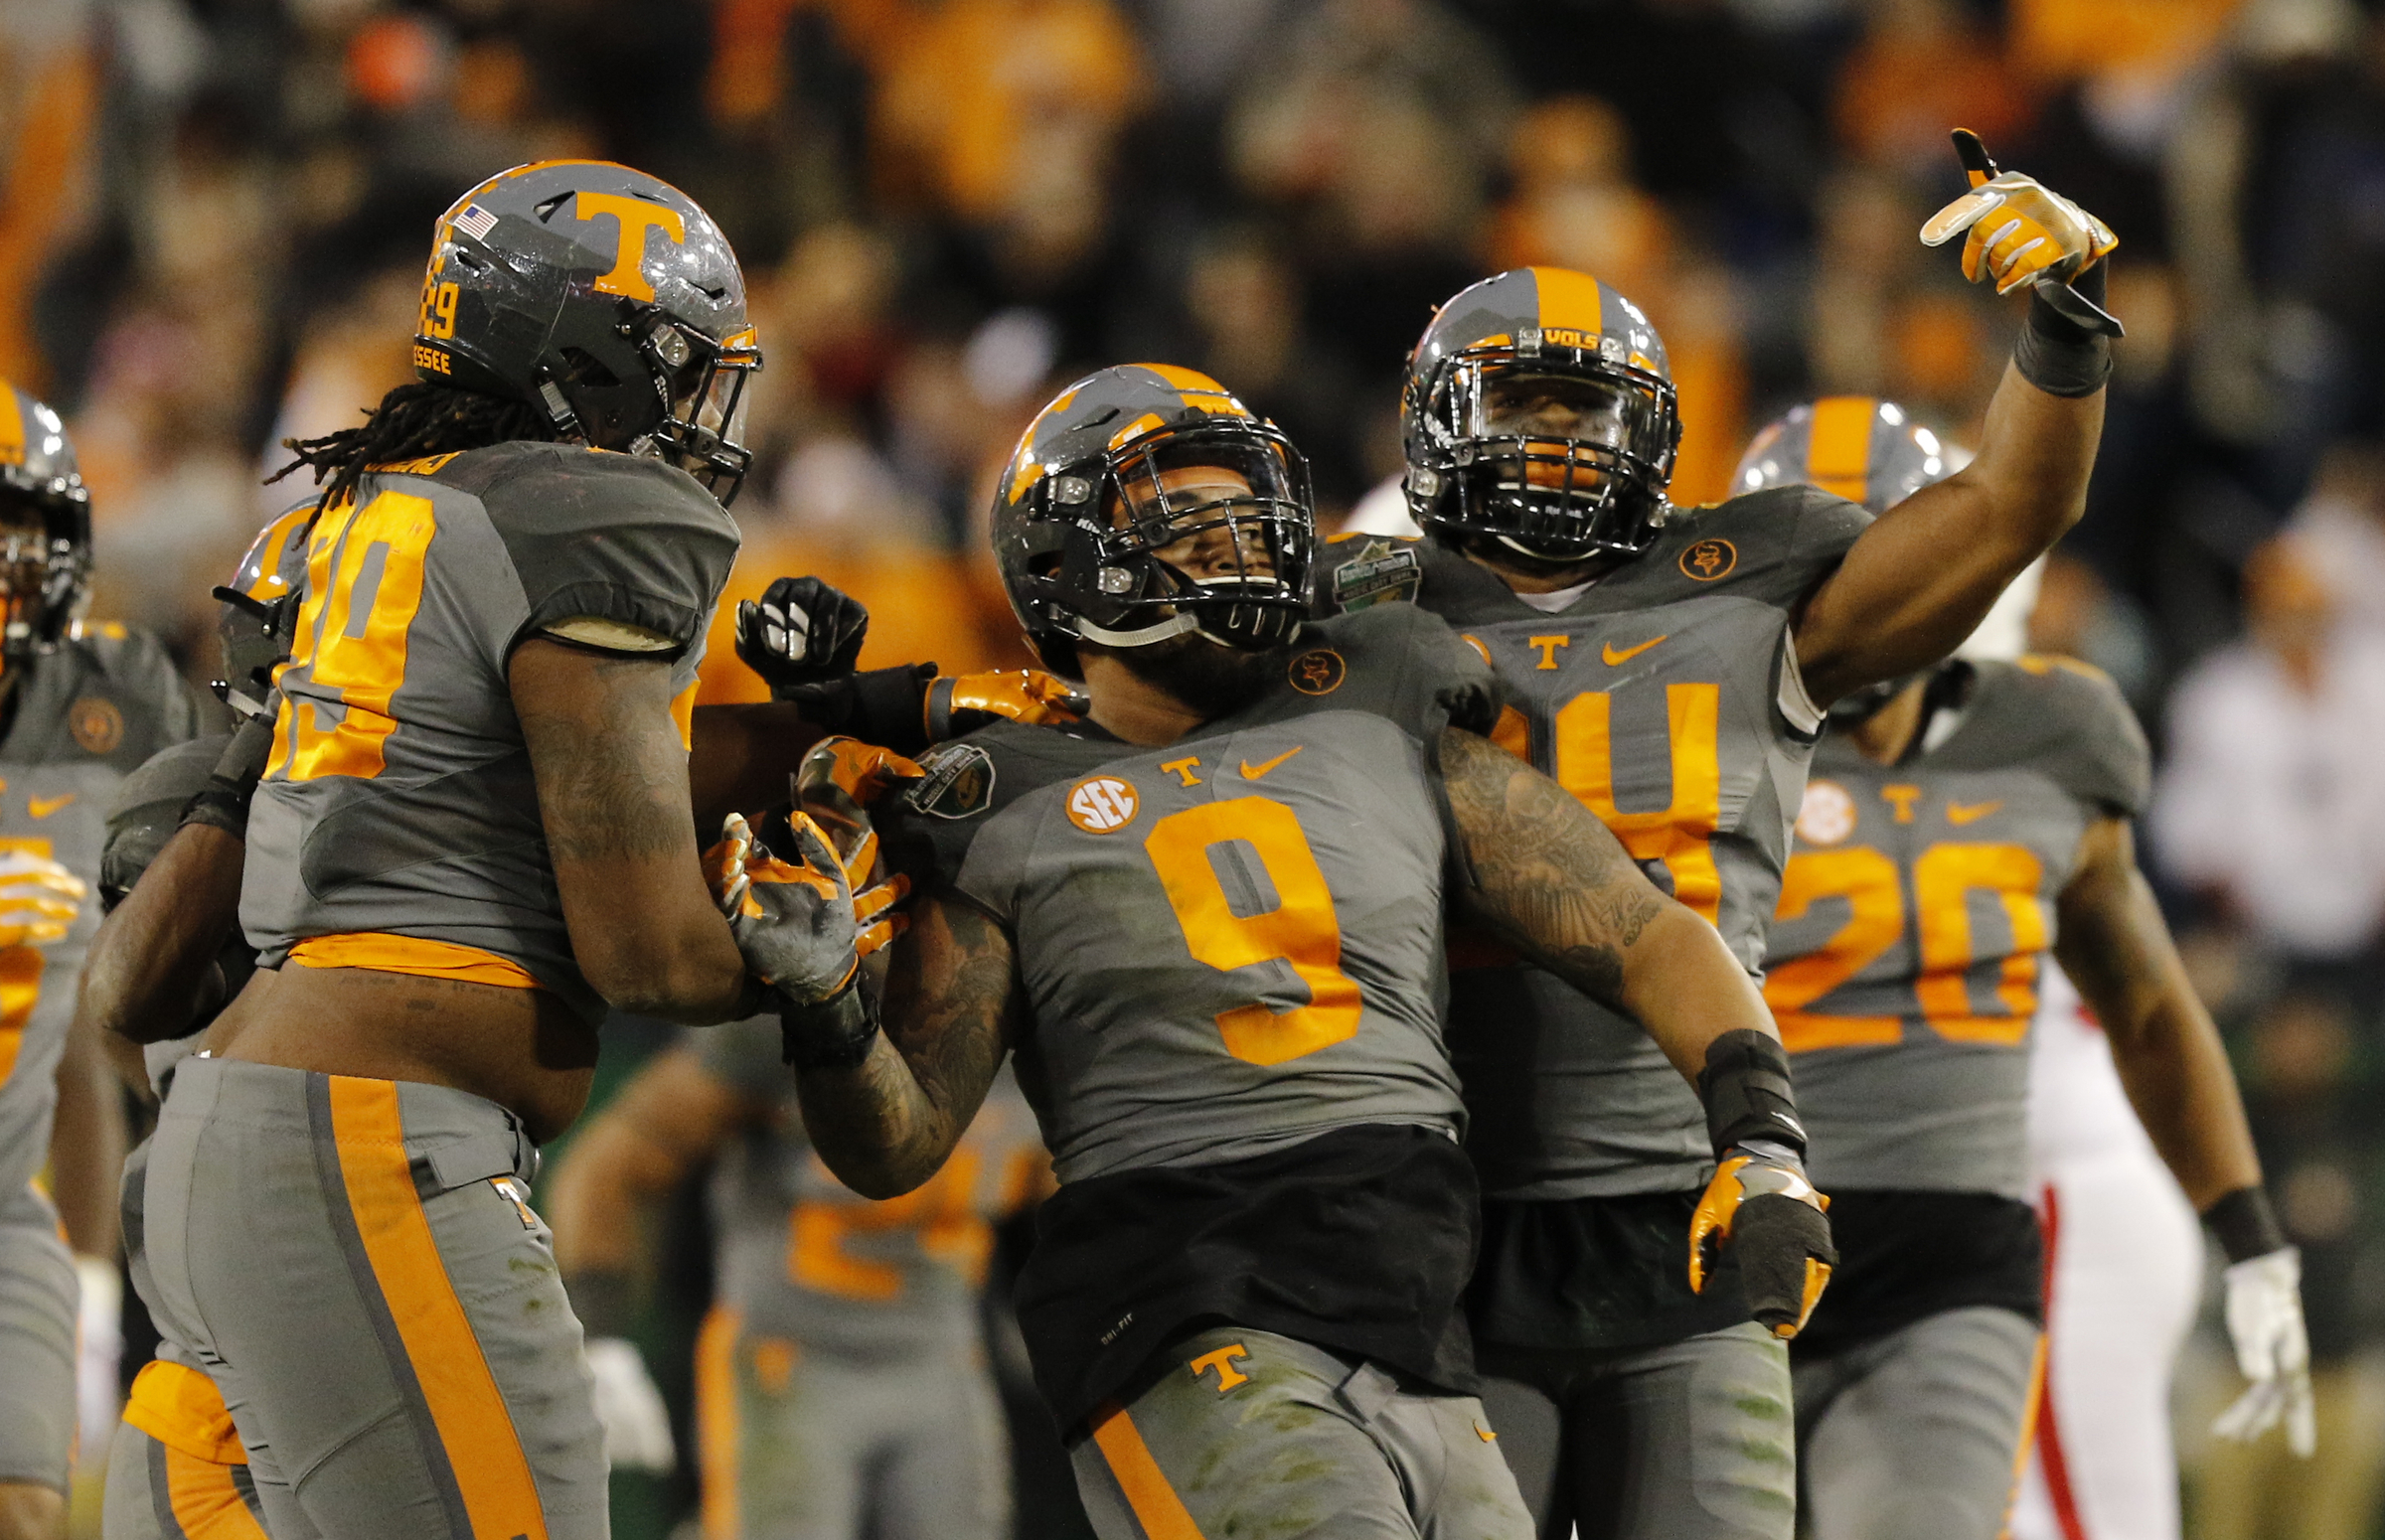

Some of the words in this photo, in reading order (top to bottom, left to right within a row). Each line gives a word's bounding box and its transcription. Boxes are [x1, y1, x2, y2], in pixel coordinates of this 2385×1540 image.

[575, 191, 686, 303] T
[1544, 328, 1599, 350] VOLS
[1529, 635, 1569, 670] T
[1160, 756, 1202, 787] T
[1071, 779, 1134, 829] SEC
[1489, 683, 1721, 928] 4
[1144, 796, 1361, 1066] 9
[1762, 842, 2045, 1053] 20
[1190, 1343, 1248, 1393] T
